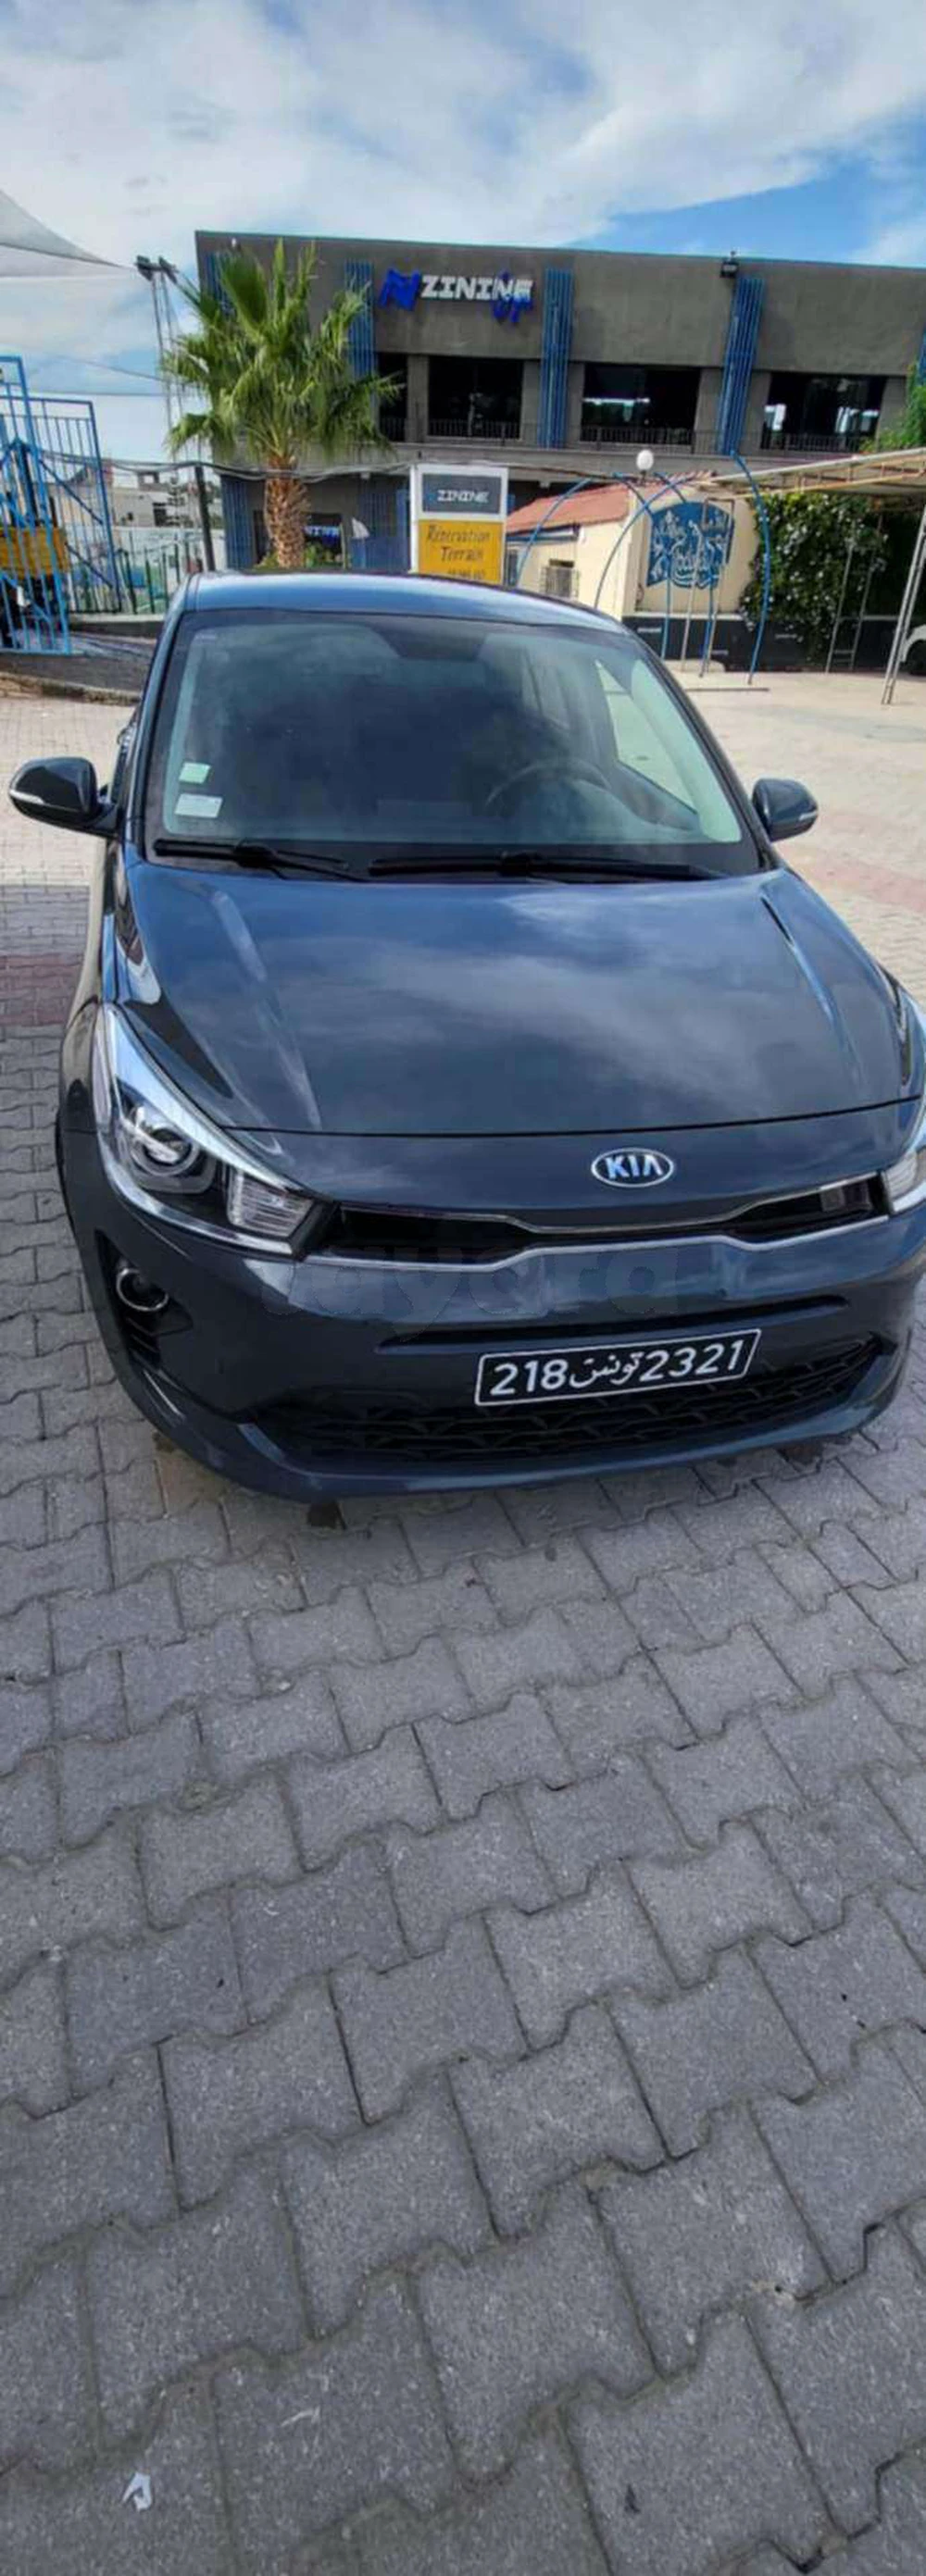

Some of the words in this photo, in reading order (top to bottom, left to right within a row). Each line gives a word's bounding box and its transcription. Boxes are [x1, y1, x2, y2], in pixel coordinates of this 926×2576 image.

[605, 1153, 664, 1179] KIA
[490, 1359, 569, 1395] 218
[640, 1339, 745, 1383] 2321
